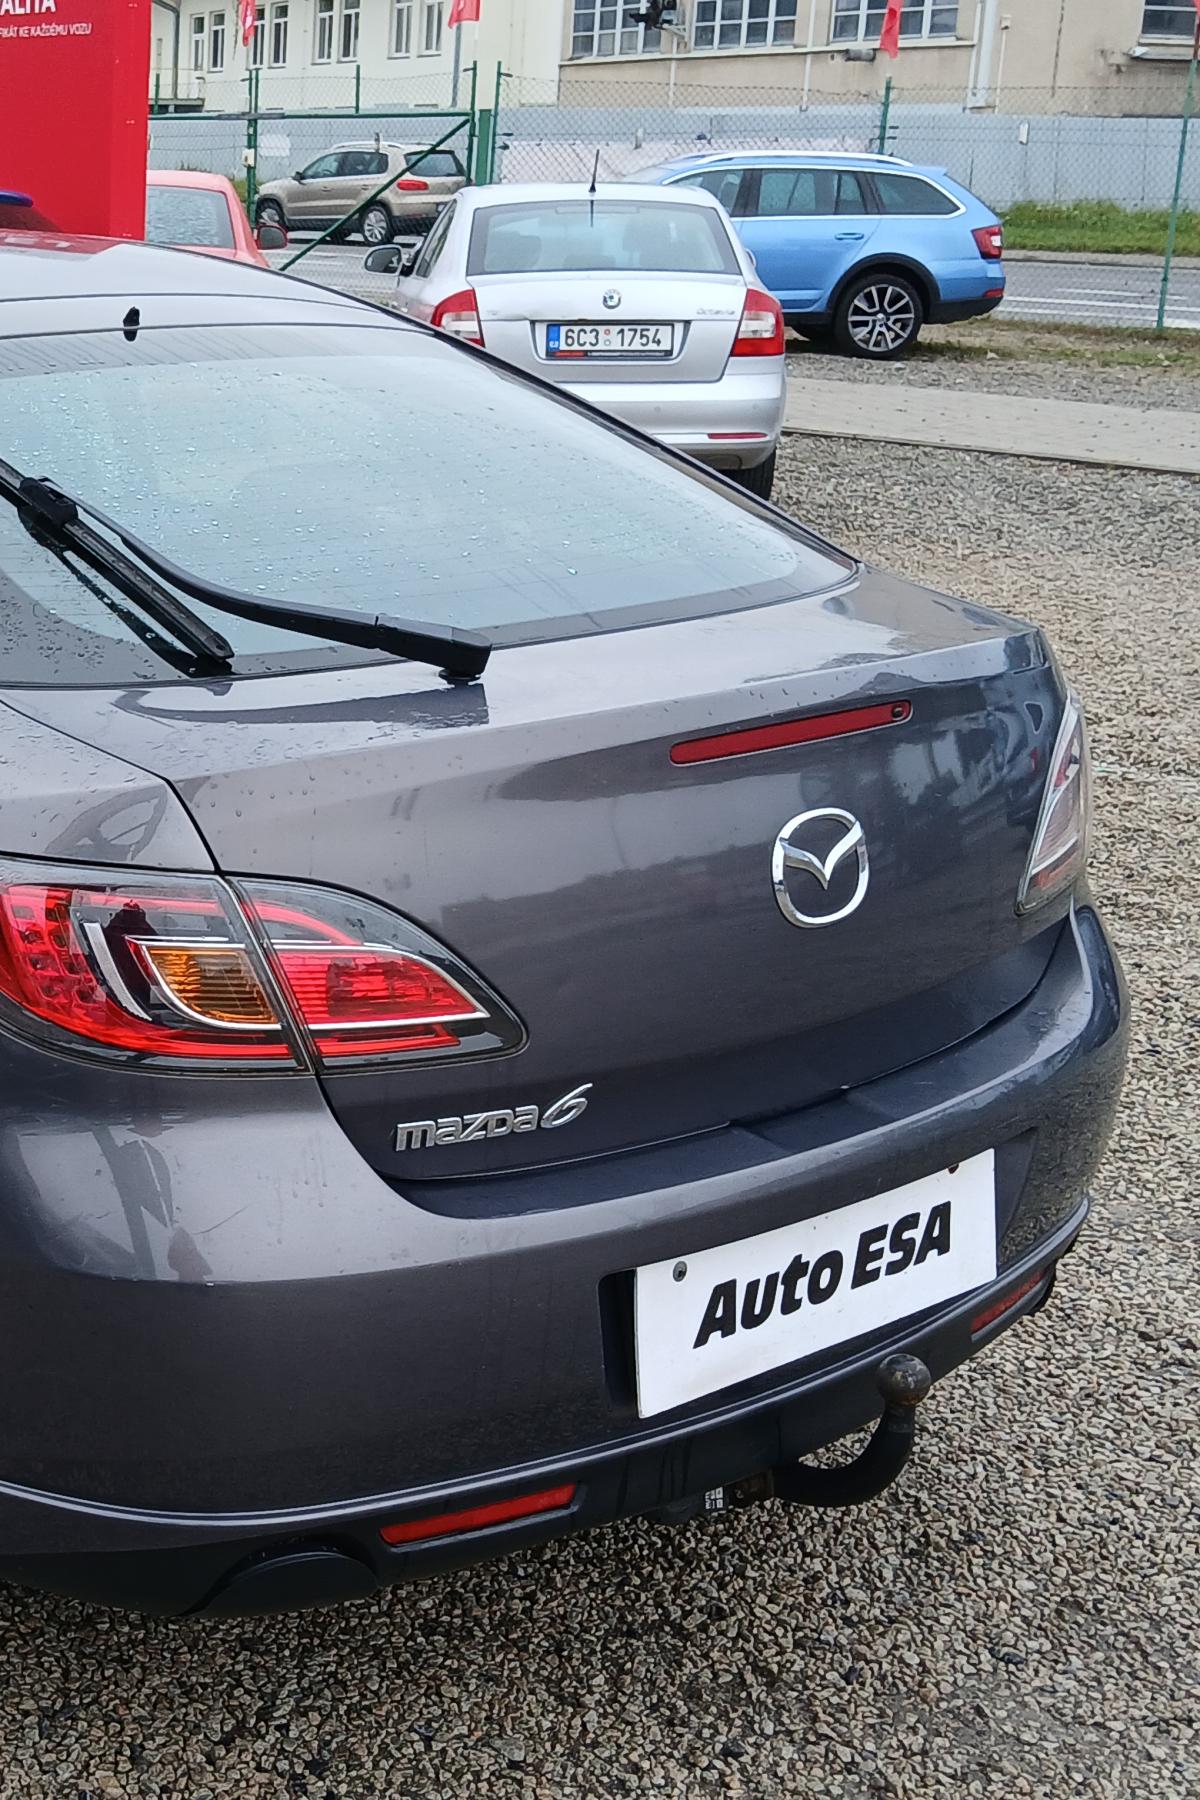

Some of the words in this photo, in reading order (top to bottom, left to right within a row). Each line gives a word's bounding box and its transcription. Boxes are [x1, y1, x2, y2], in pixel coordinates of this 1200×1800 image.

[565, 328, 599, 347] 6C3
[617, 328, 661, 347] 1754
[693, 1250, 844, 1349] Auto
[850, 1200, 952, 1290] ESA
